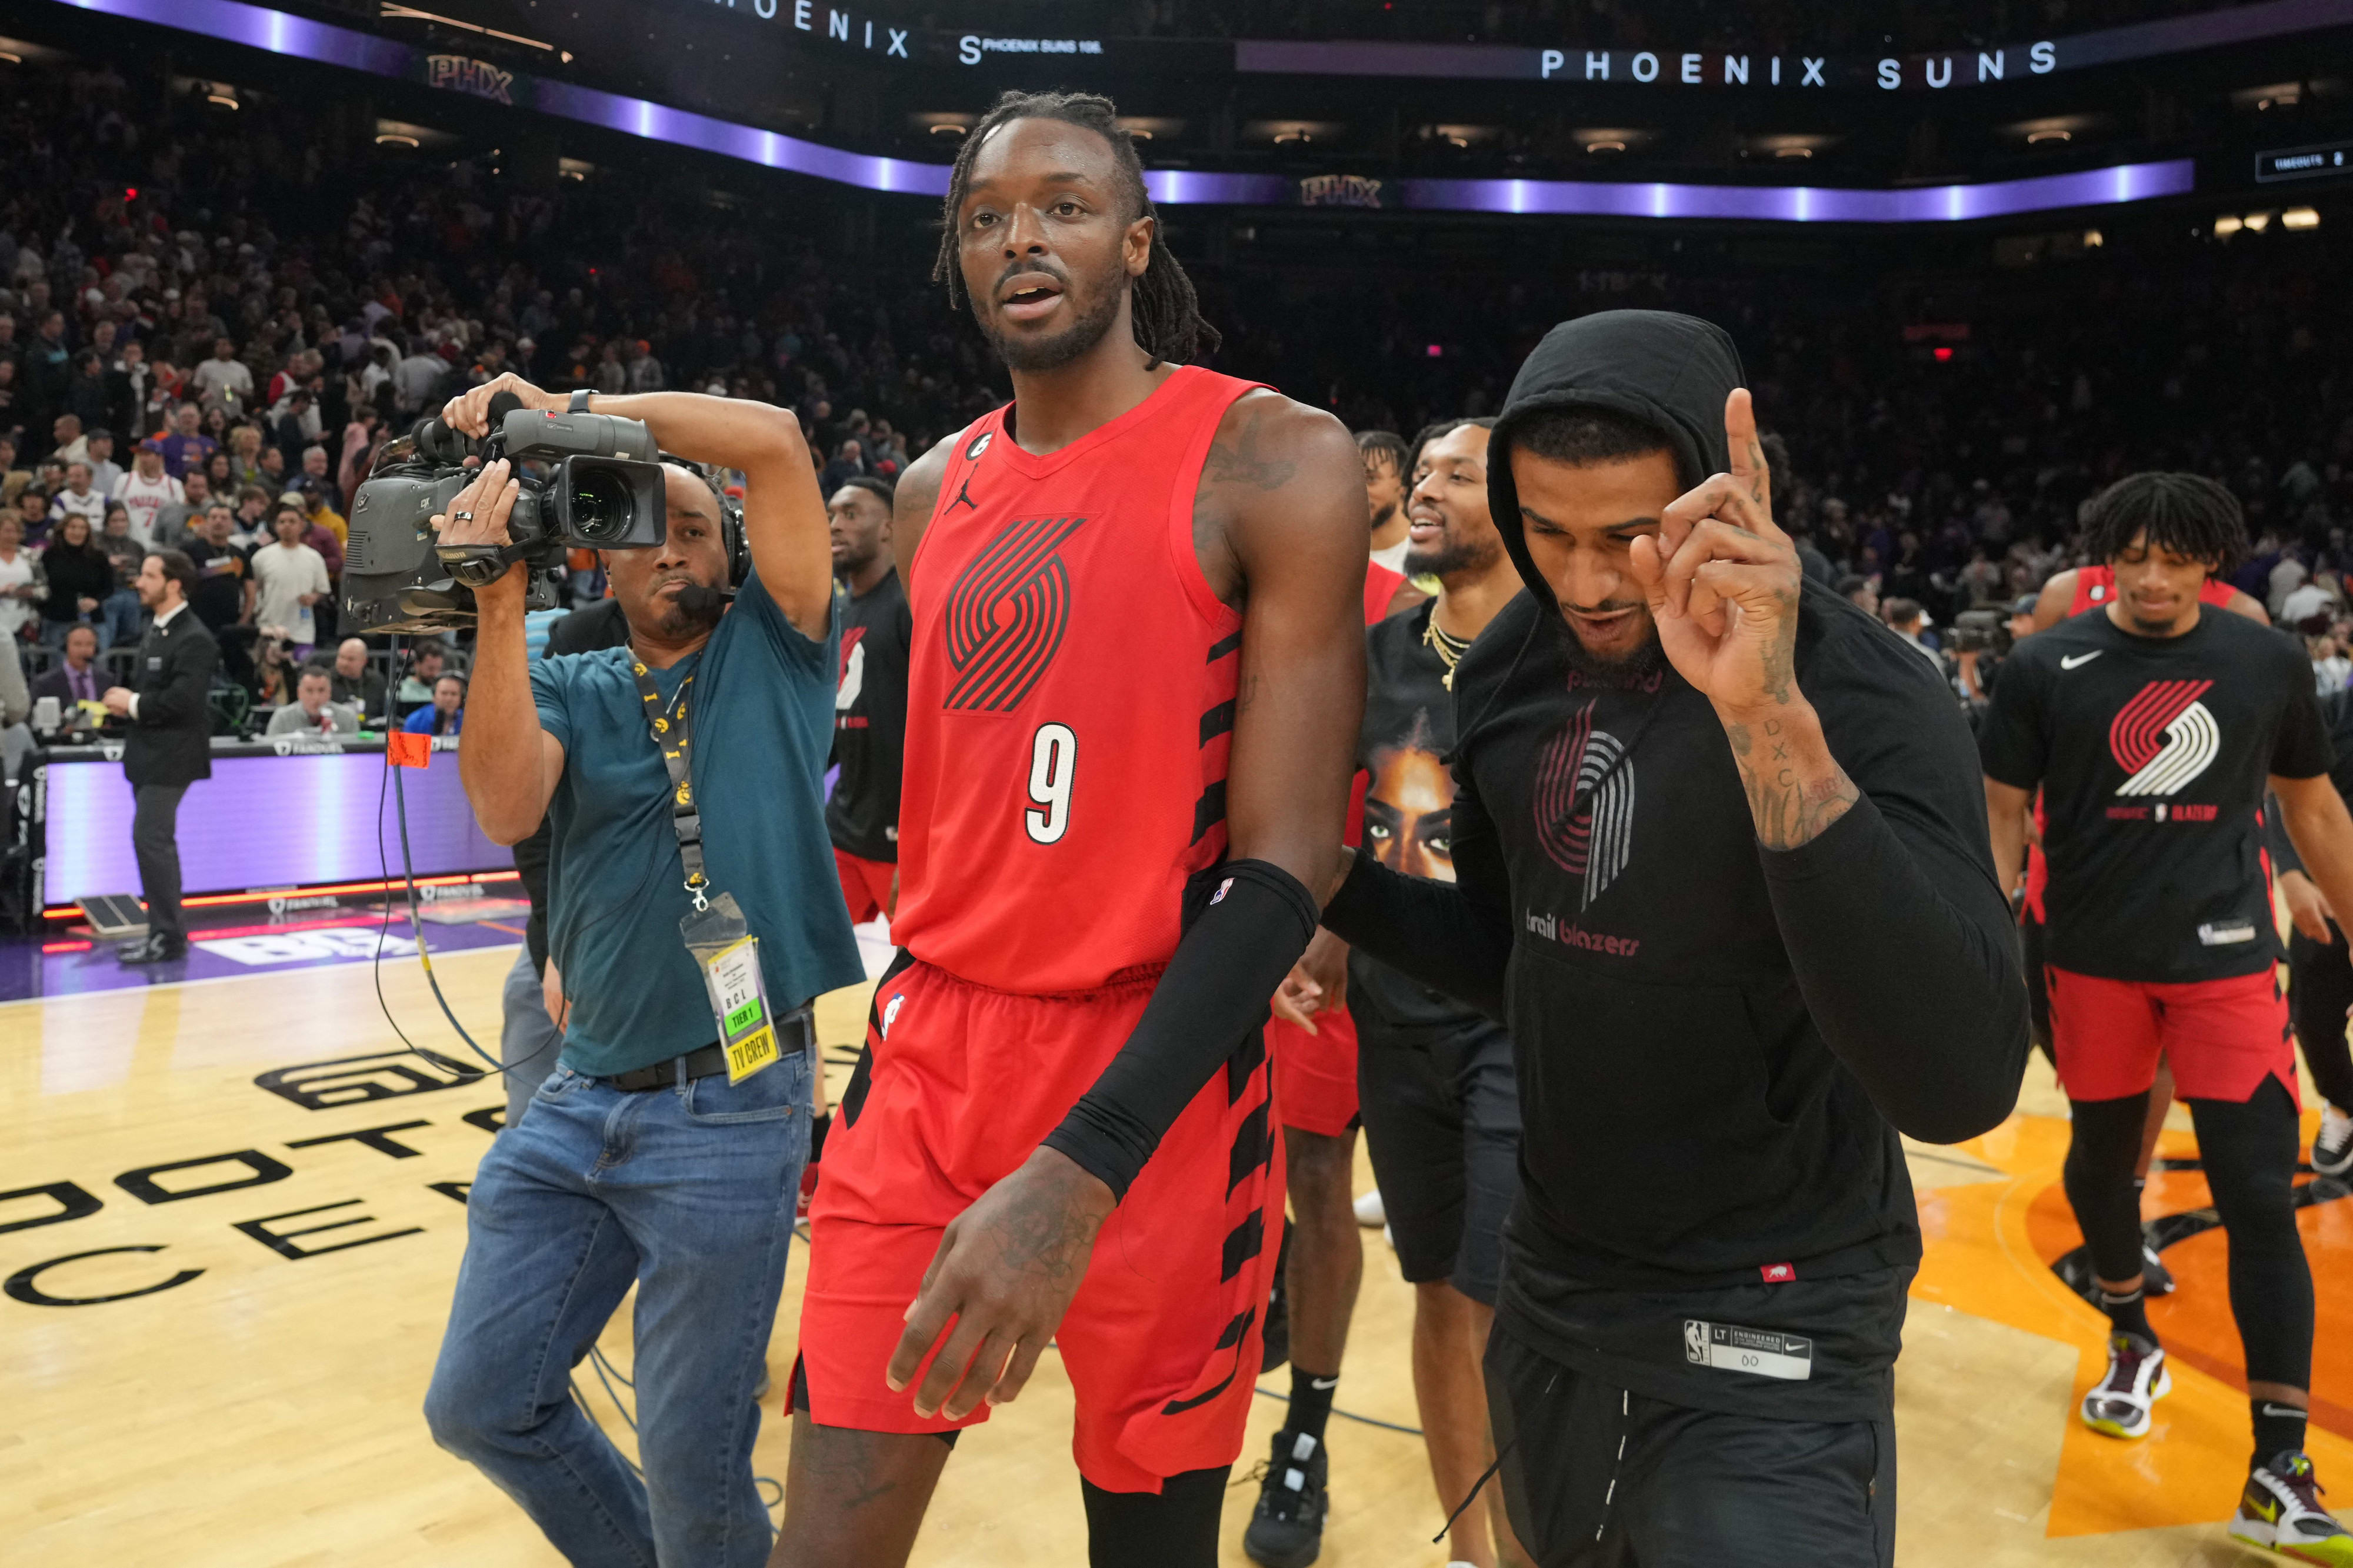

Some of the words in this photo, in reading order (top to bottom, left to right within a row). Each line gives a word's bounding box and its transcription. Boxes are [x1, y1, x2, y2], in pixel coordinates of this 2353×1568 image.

[714, 0, 909, 59] OENIX
[1541, 49, 1825, 87] PHOENIX
[1877, 41, 2056, 89] SUNS
[1024, 721, 1078, 846] 9
[1527, 908, 1556, 941] trail
[1559, 918, 1640, 956] blazers
[732, 1011, 748, 1027] TIER
[748, 1007, 754, 1018] 1
[732, 1047, 745, 1071] TV
[745, 1032, 770, 1064] CREW
[1714, 1329, 1727, 1340] LT
[1734, 1330, 1781, 1344] ENGINEERED
